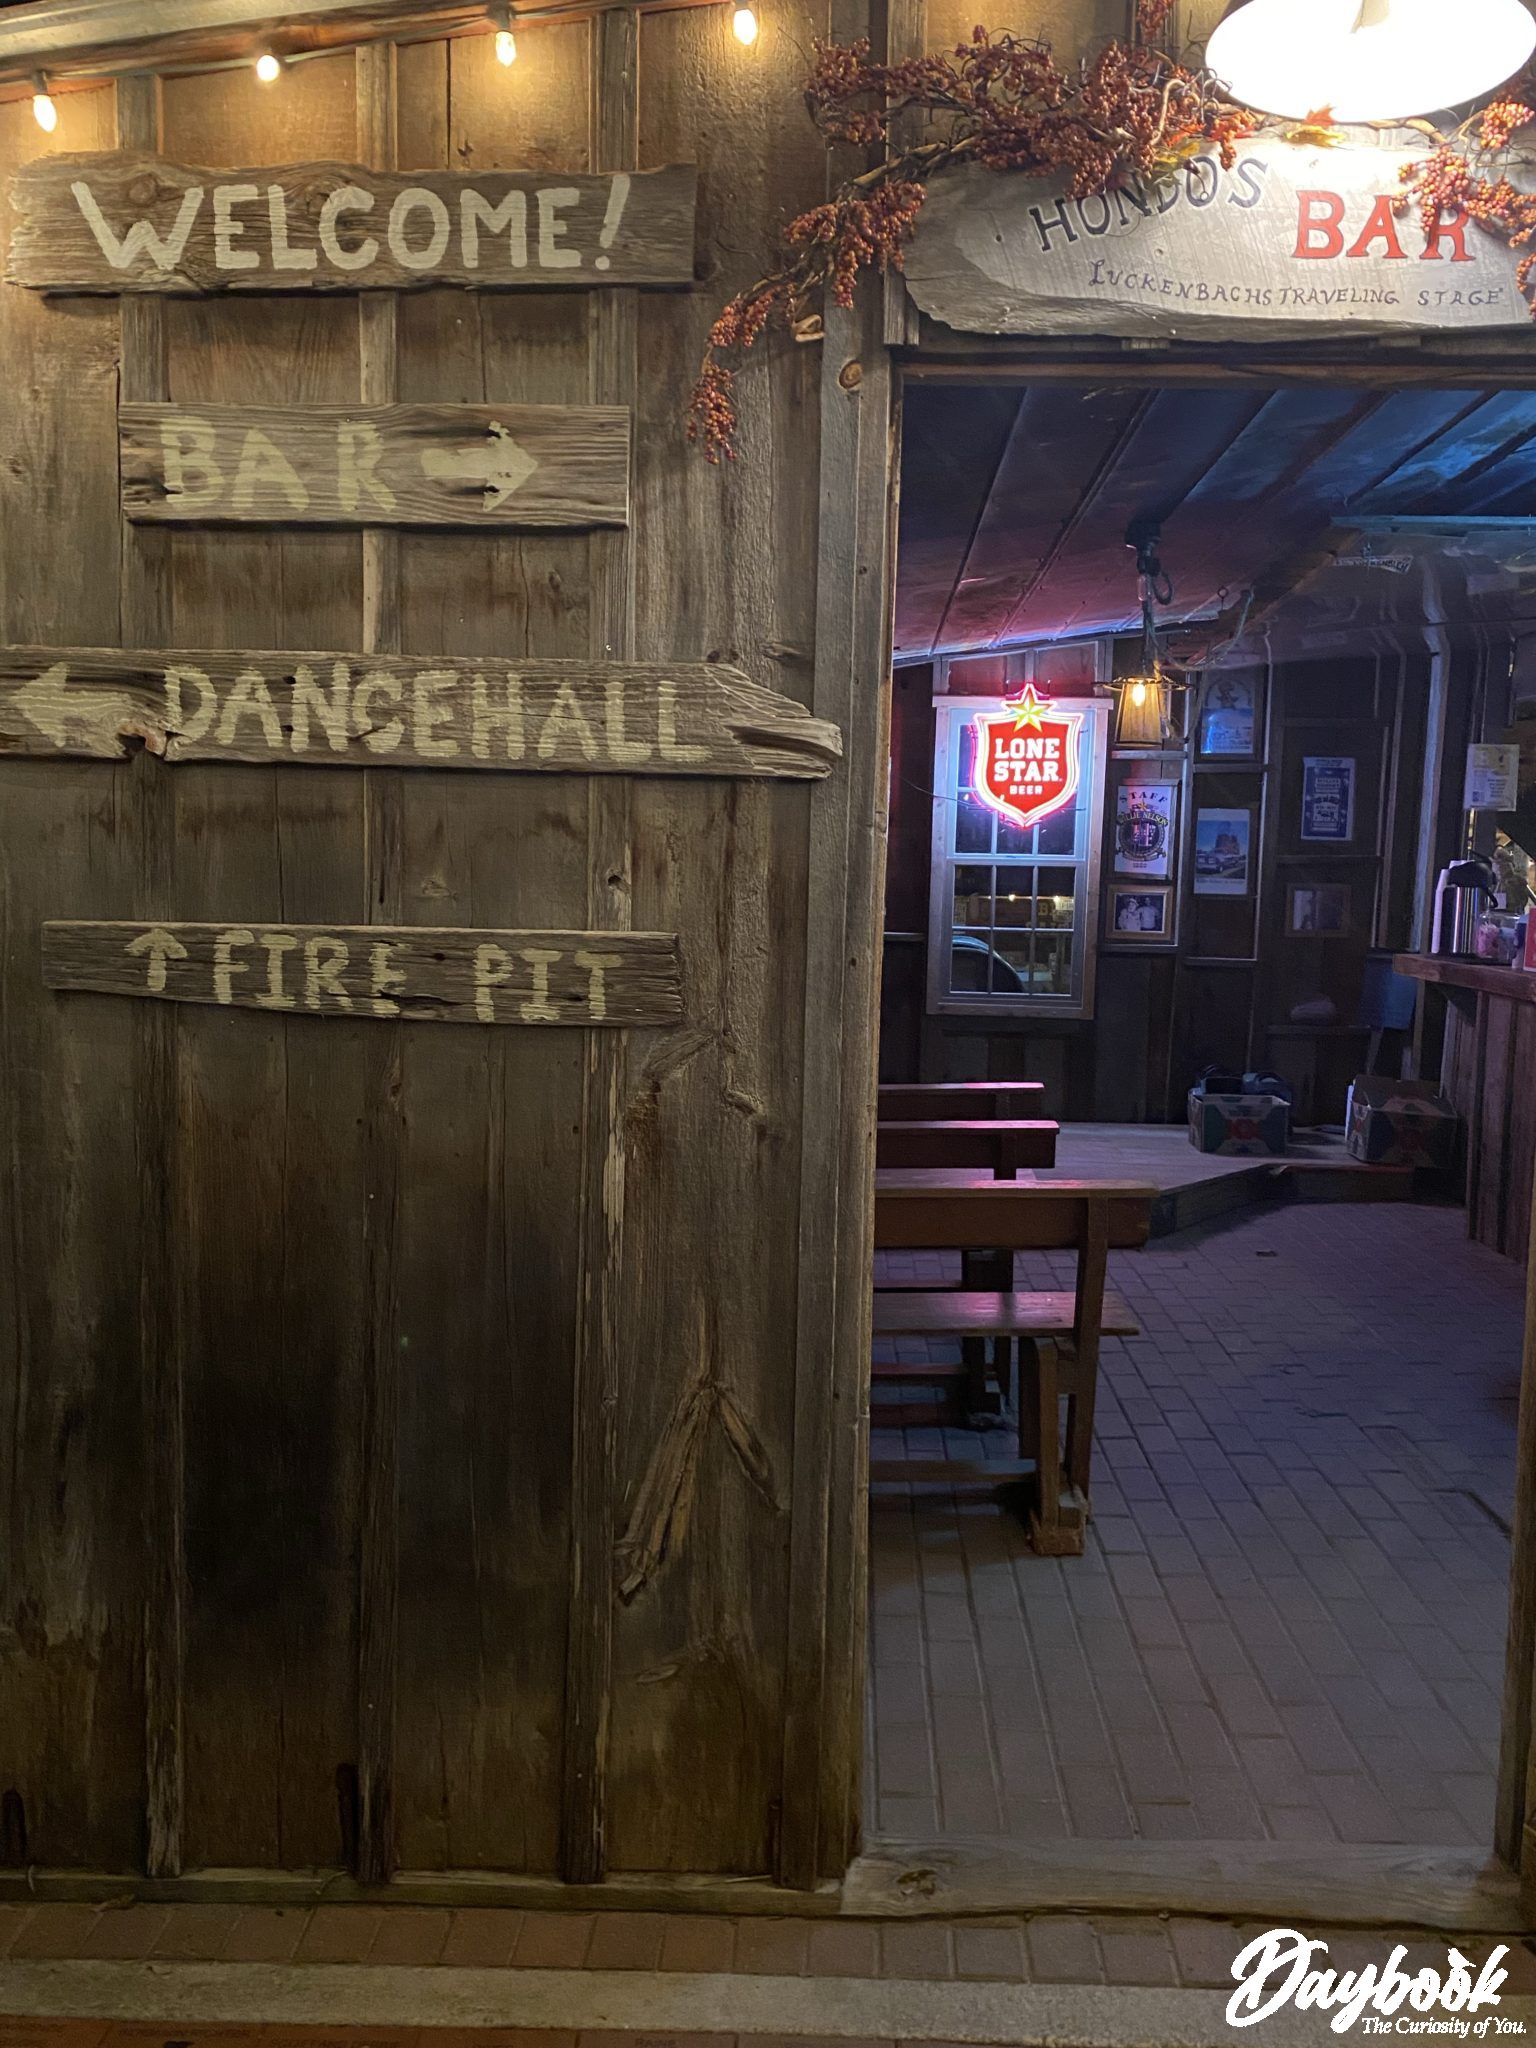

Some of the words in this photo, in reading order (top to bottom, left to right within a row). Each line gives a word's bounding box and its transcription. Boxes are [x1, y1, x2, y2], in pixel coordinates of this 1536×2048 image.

[71, 175, 630, 270] WELCOME!
[1029, 156, 1268, 252] HONDOS
[1291, 190, 1476, 262] BAR
[1278, 286, 1400, 305] TRAVELING
[159, 416, 396, 513] BAR
[164, 661, 712, 762] DANCEHALL
[993, 761, 1060, 782] STAR
[994, 738, 1060, 760] LONE
[1009, 785, 1043, 796] BEER
[1119, 791, 1168, 803] STAFF
[212, 929, 403, 1018] FIRE
[473, 943, 624, 1022] PIT
